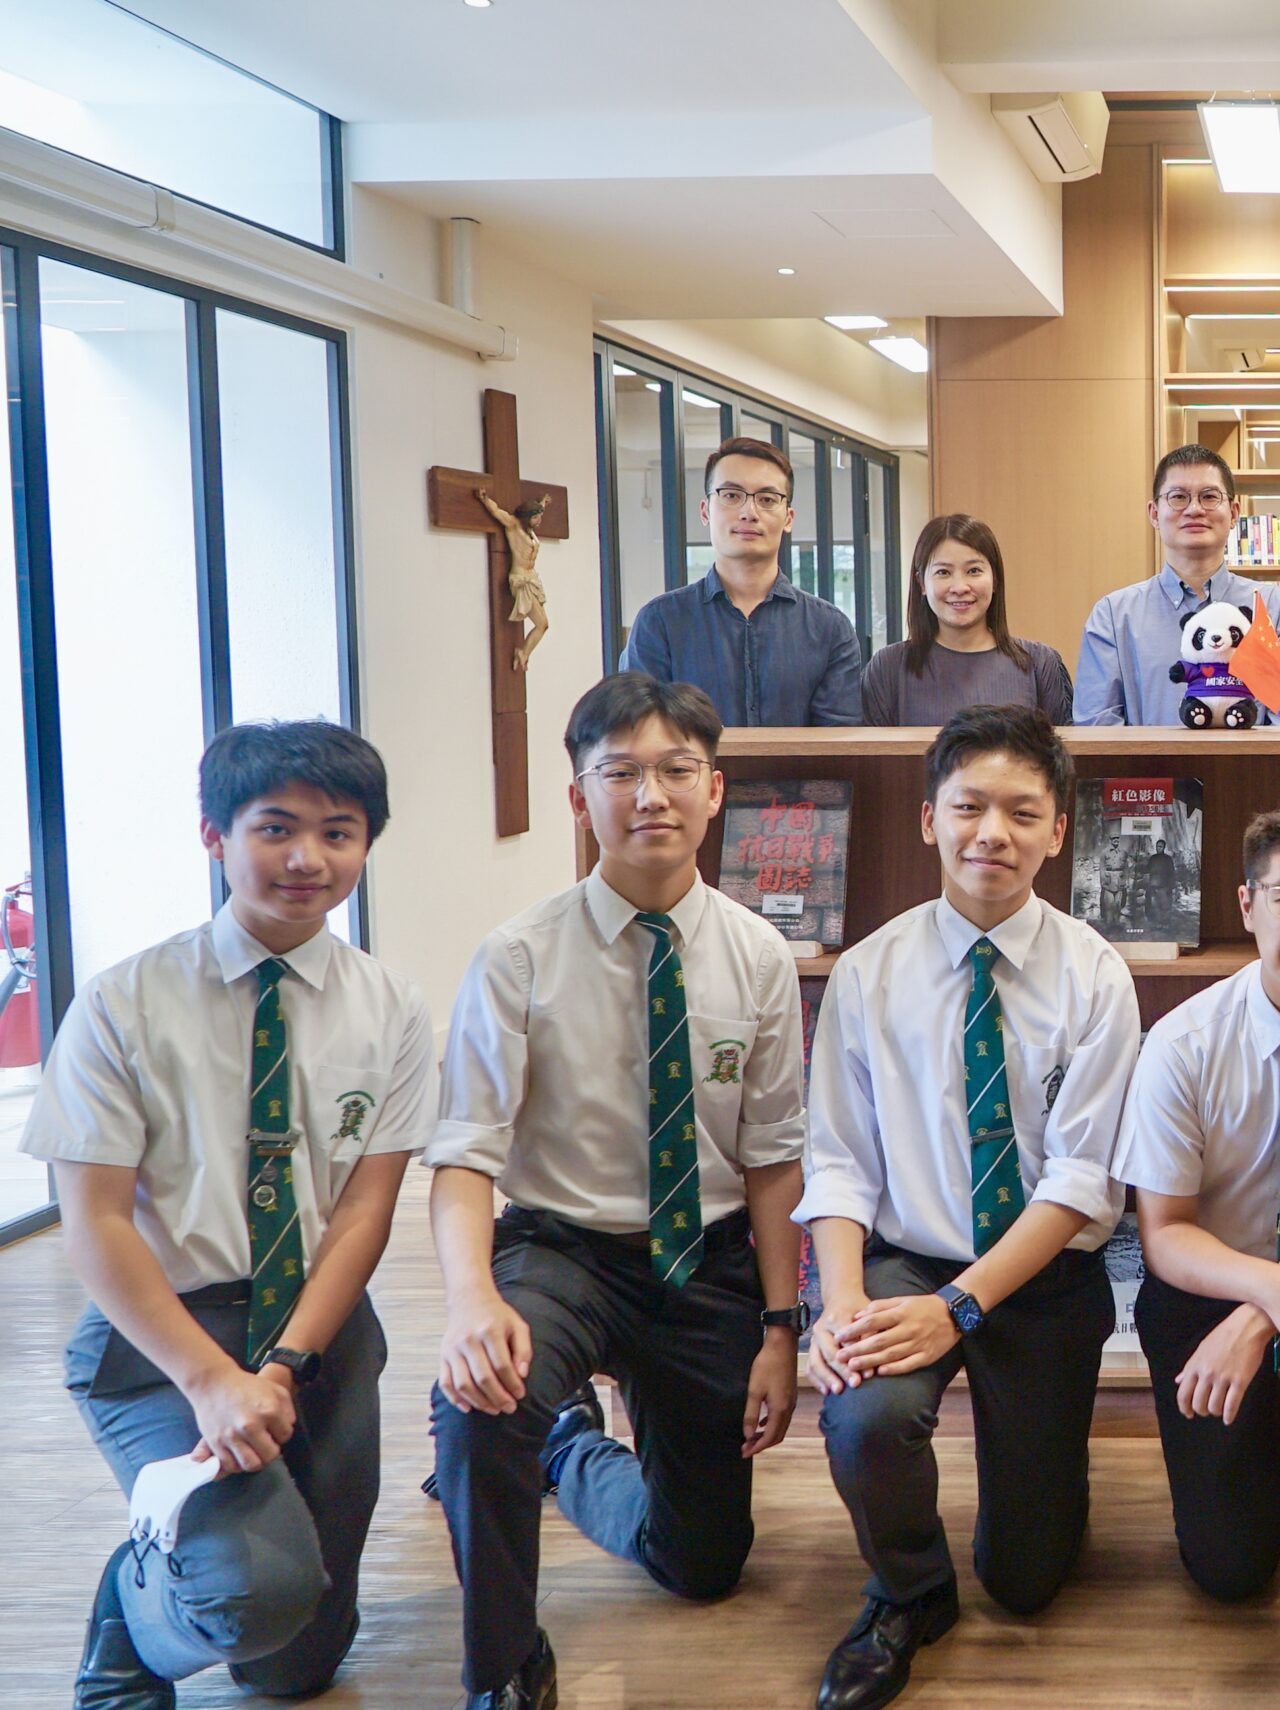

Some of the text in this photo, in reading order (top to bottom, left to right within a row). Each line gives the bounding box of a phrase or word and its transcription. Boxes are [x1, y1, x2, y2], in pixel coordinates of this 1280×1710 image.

[1111, 789, 1166, 802] 紅色影像
[758, 795, 816, 832] 中國
[737, 832, 834, 864] 抗日戰爭
